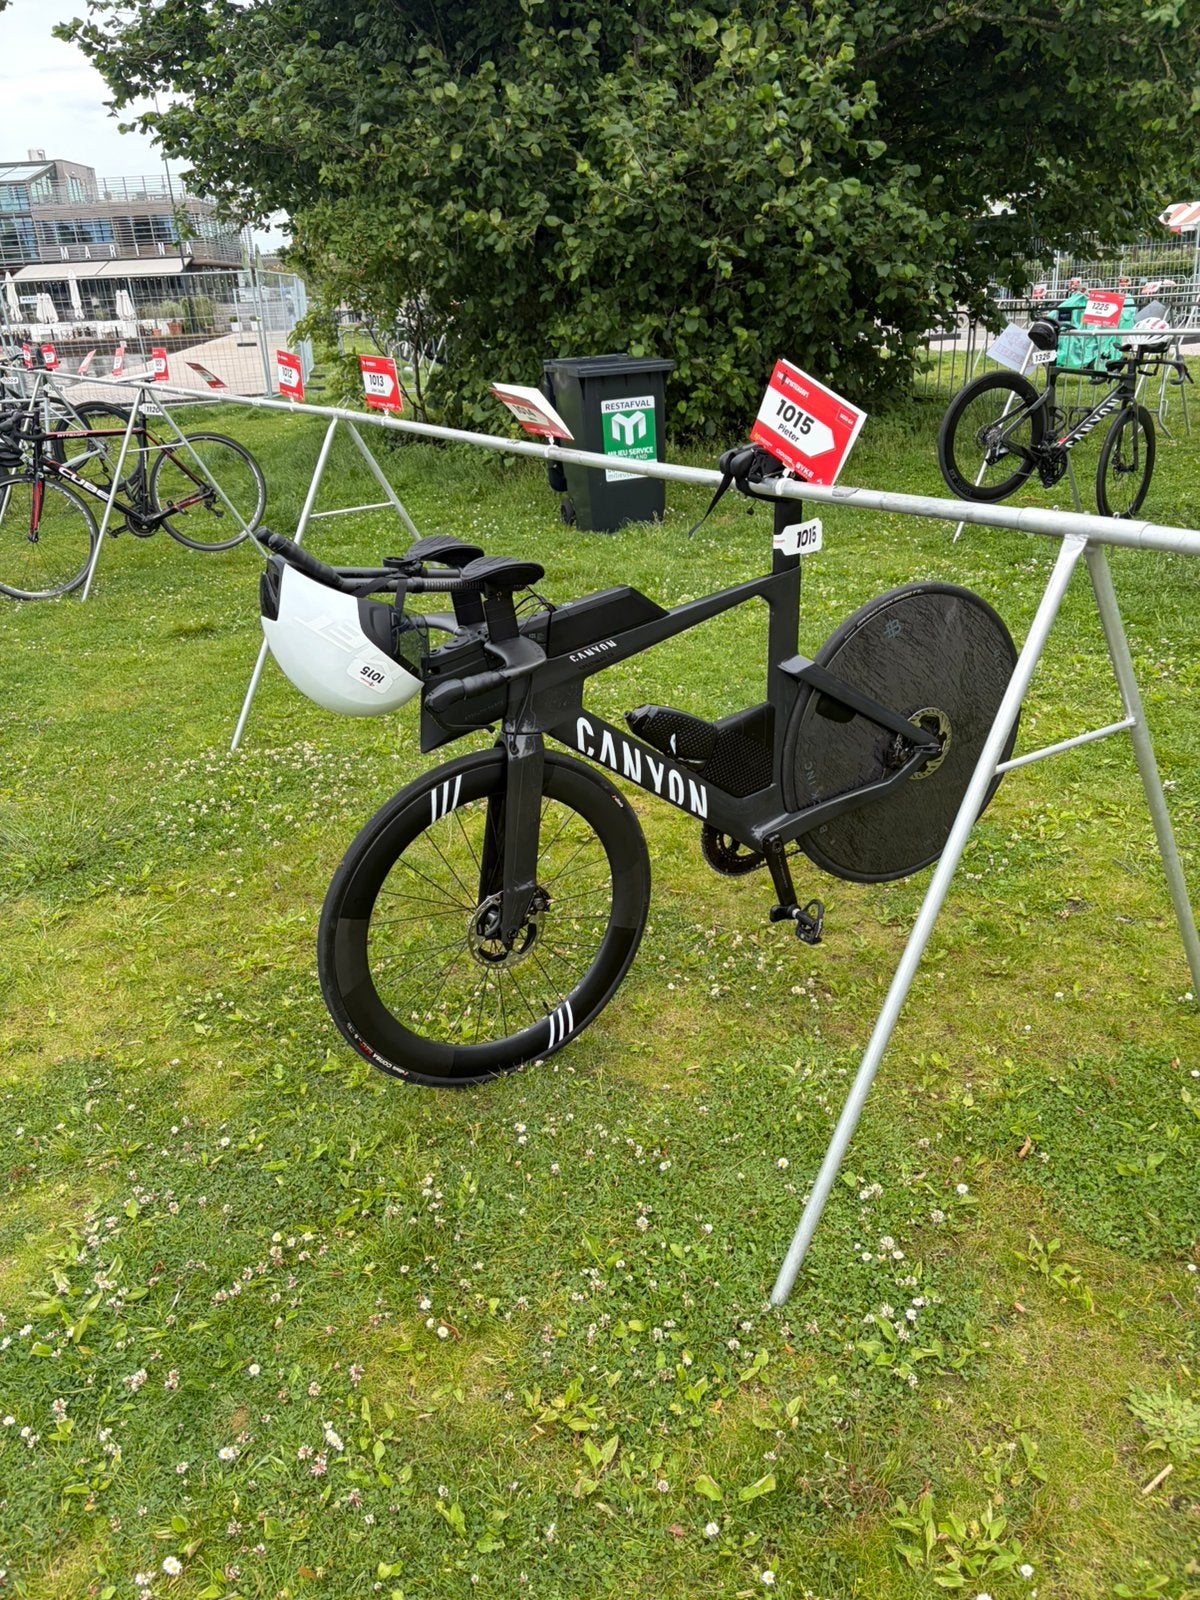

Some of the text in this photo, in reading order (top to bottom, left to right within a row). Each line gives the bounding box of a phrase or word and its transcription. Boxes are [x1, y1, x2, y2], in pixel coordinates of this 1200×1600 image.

[60, 241, 192, 260] MARINA
[1092, 302, 1110, 311] 1225
[282, 366, 293, 379] 1012
[369, 374, 384, 387] 1013
[605, 398, 651, 411] RESTAFVAL
[775, 399, 814, 435] 1015
[1065, 398, 1120, 449] CANYON
[778, 423, 800, 443] Pieter
[629, 446, 654, 456] SERVICE
[58, 466, 110, 502] CUBE
[796, 525, 817, 549] 1015
[569, 639, 617, 663] CANYON
[360, 664, 385, 685] 1015
[576, 716, 708, 819] CANYON
